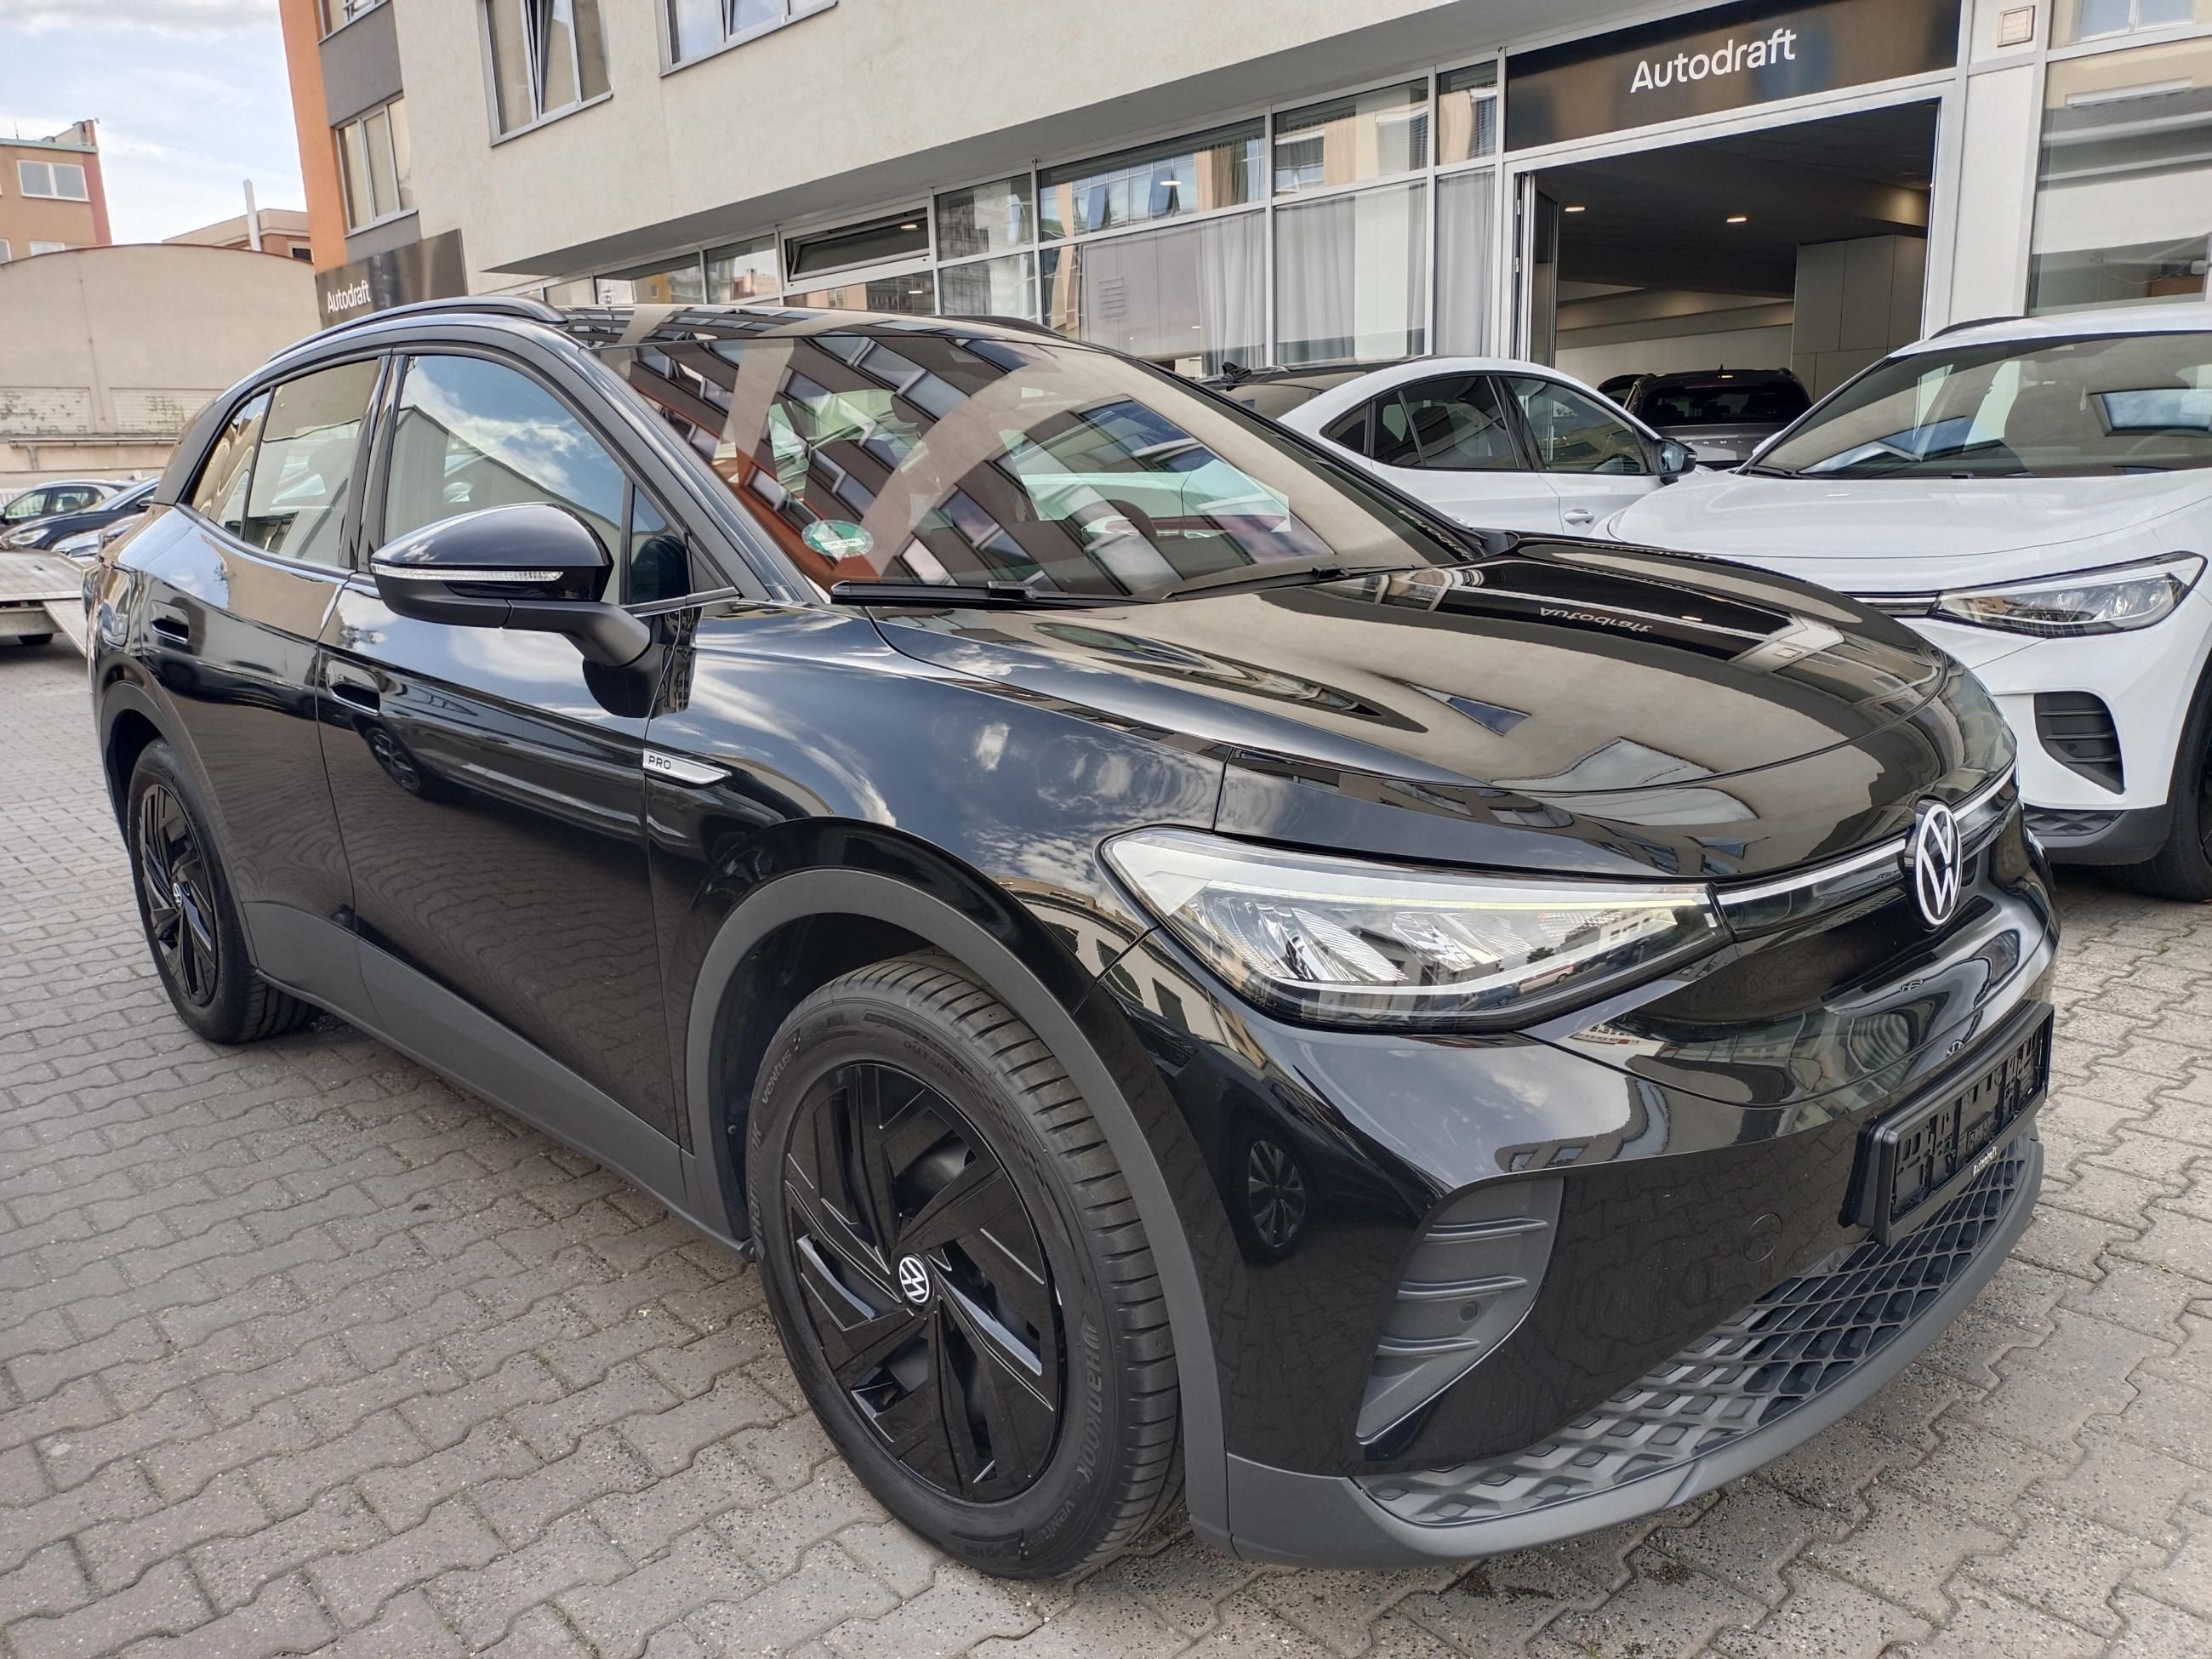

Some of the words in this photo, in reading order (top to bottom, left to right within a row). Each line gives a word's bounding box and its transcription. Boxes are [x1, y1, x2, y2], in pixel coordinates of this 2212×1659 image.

[1630, 28, 1797, 93] Autodraft
[327, 279, 371, 313] Autodraft
[648, 755, 671, 770] PRO
